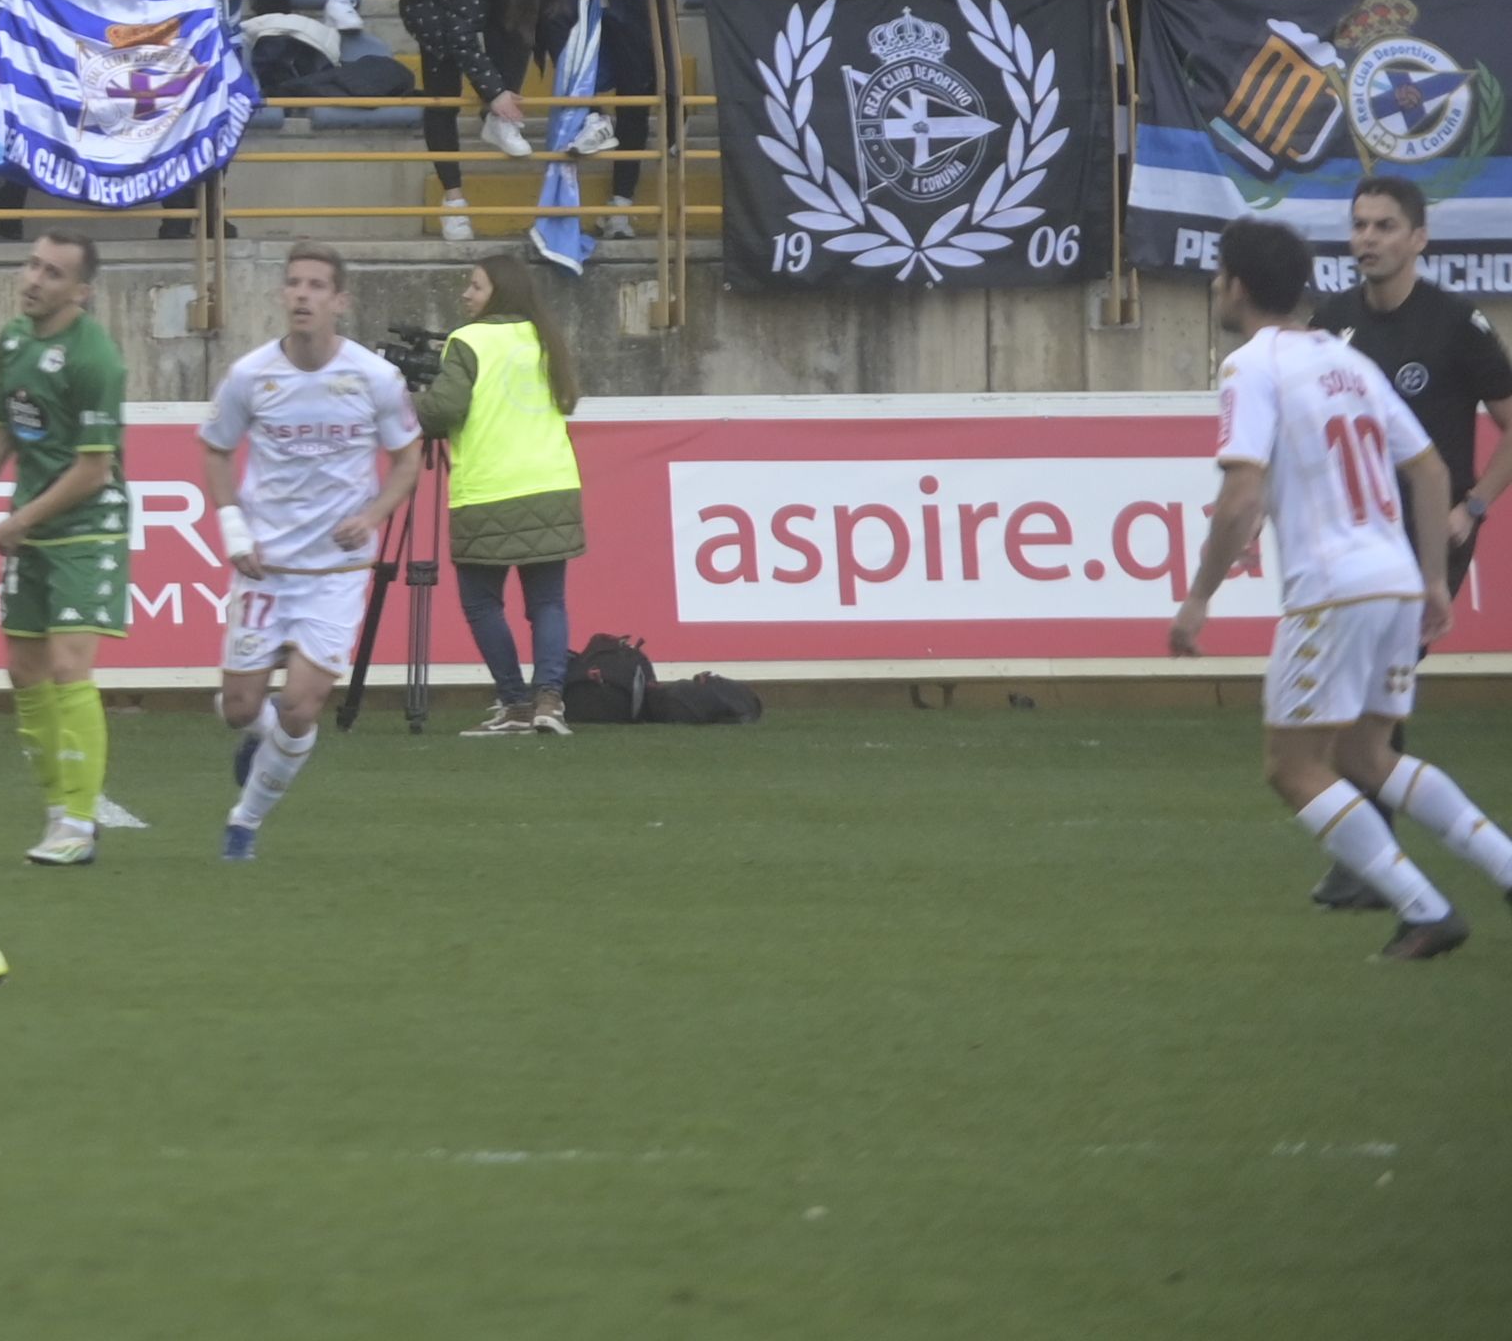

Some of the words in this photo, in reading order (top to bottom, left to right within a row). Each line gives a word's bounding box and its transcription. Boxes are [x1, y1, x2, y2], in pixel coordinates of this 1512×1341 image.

[1373, 43, 1437, 65] Deportivo
[864, 86, 886, 116] REAL
[883, 66, 913, 88] CLUB
[914, 64, 973, 107] DEPORTIVO
[1354, 61, 1374, 89] Club
[1352, 91, 1368, 125] Real
[1405, 140, 1416, 155] A
[1421, 106, 1462, 152] Coruña
[34, 147, 86, 195] CLUB
[88, 153, 191, 204] DEPORTIVO
[193, 137, 215, 174] LA
[911, 177, 920, 192] A
[921, 160, 967, 193] CORUÑA
[771, 230, 813, 273] 19
[1027, 224, 1081, 268] 06
[240, 590, 276, 631] 17
